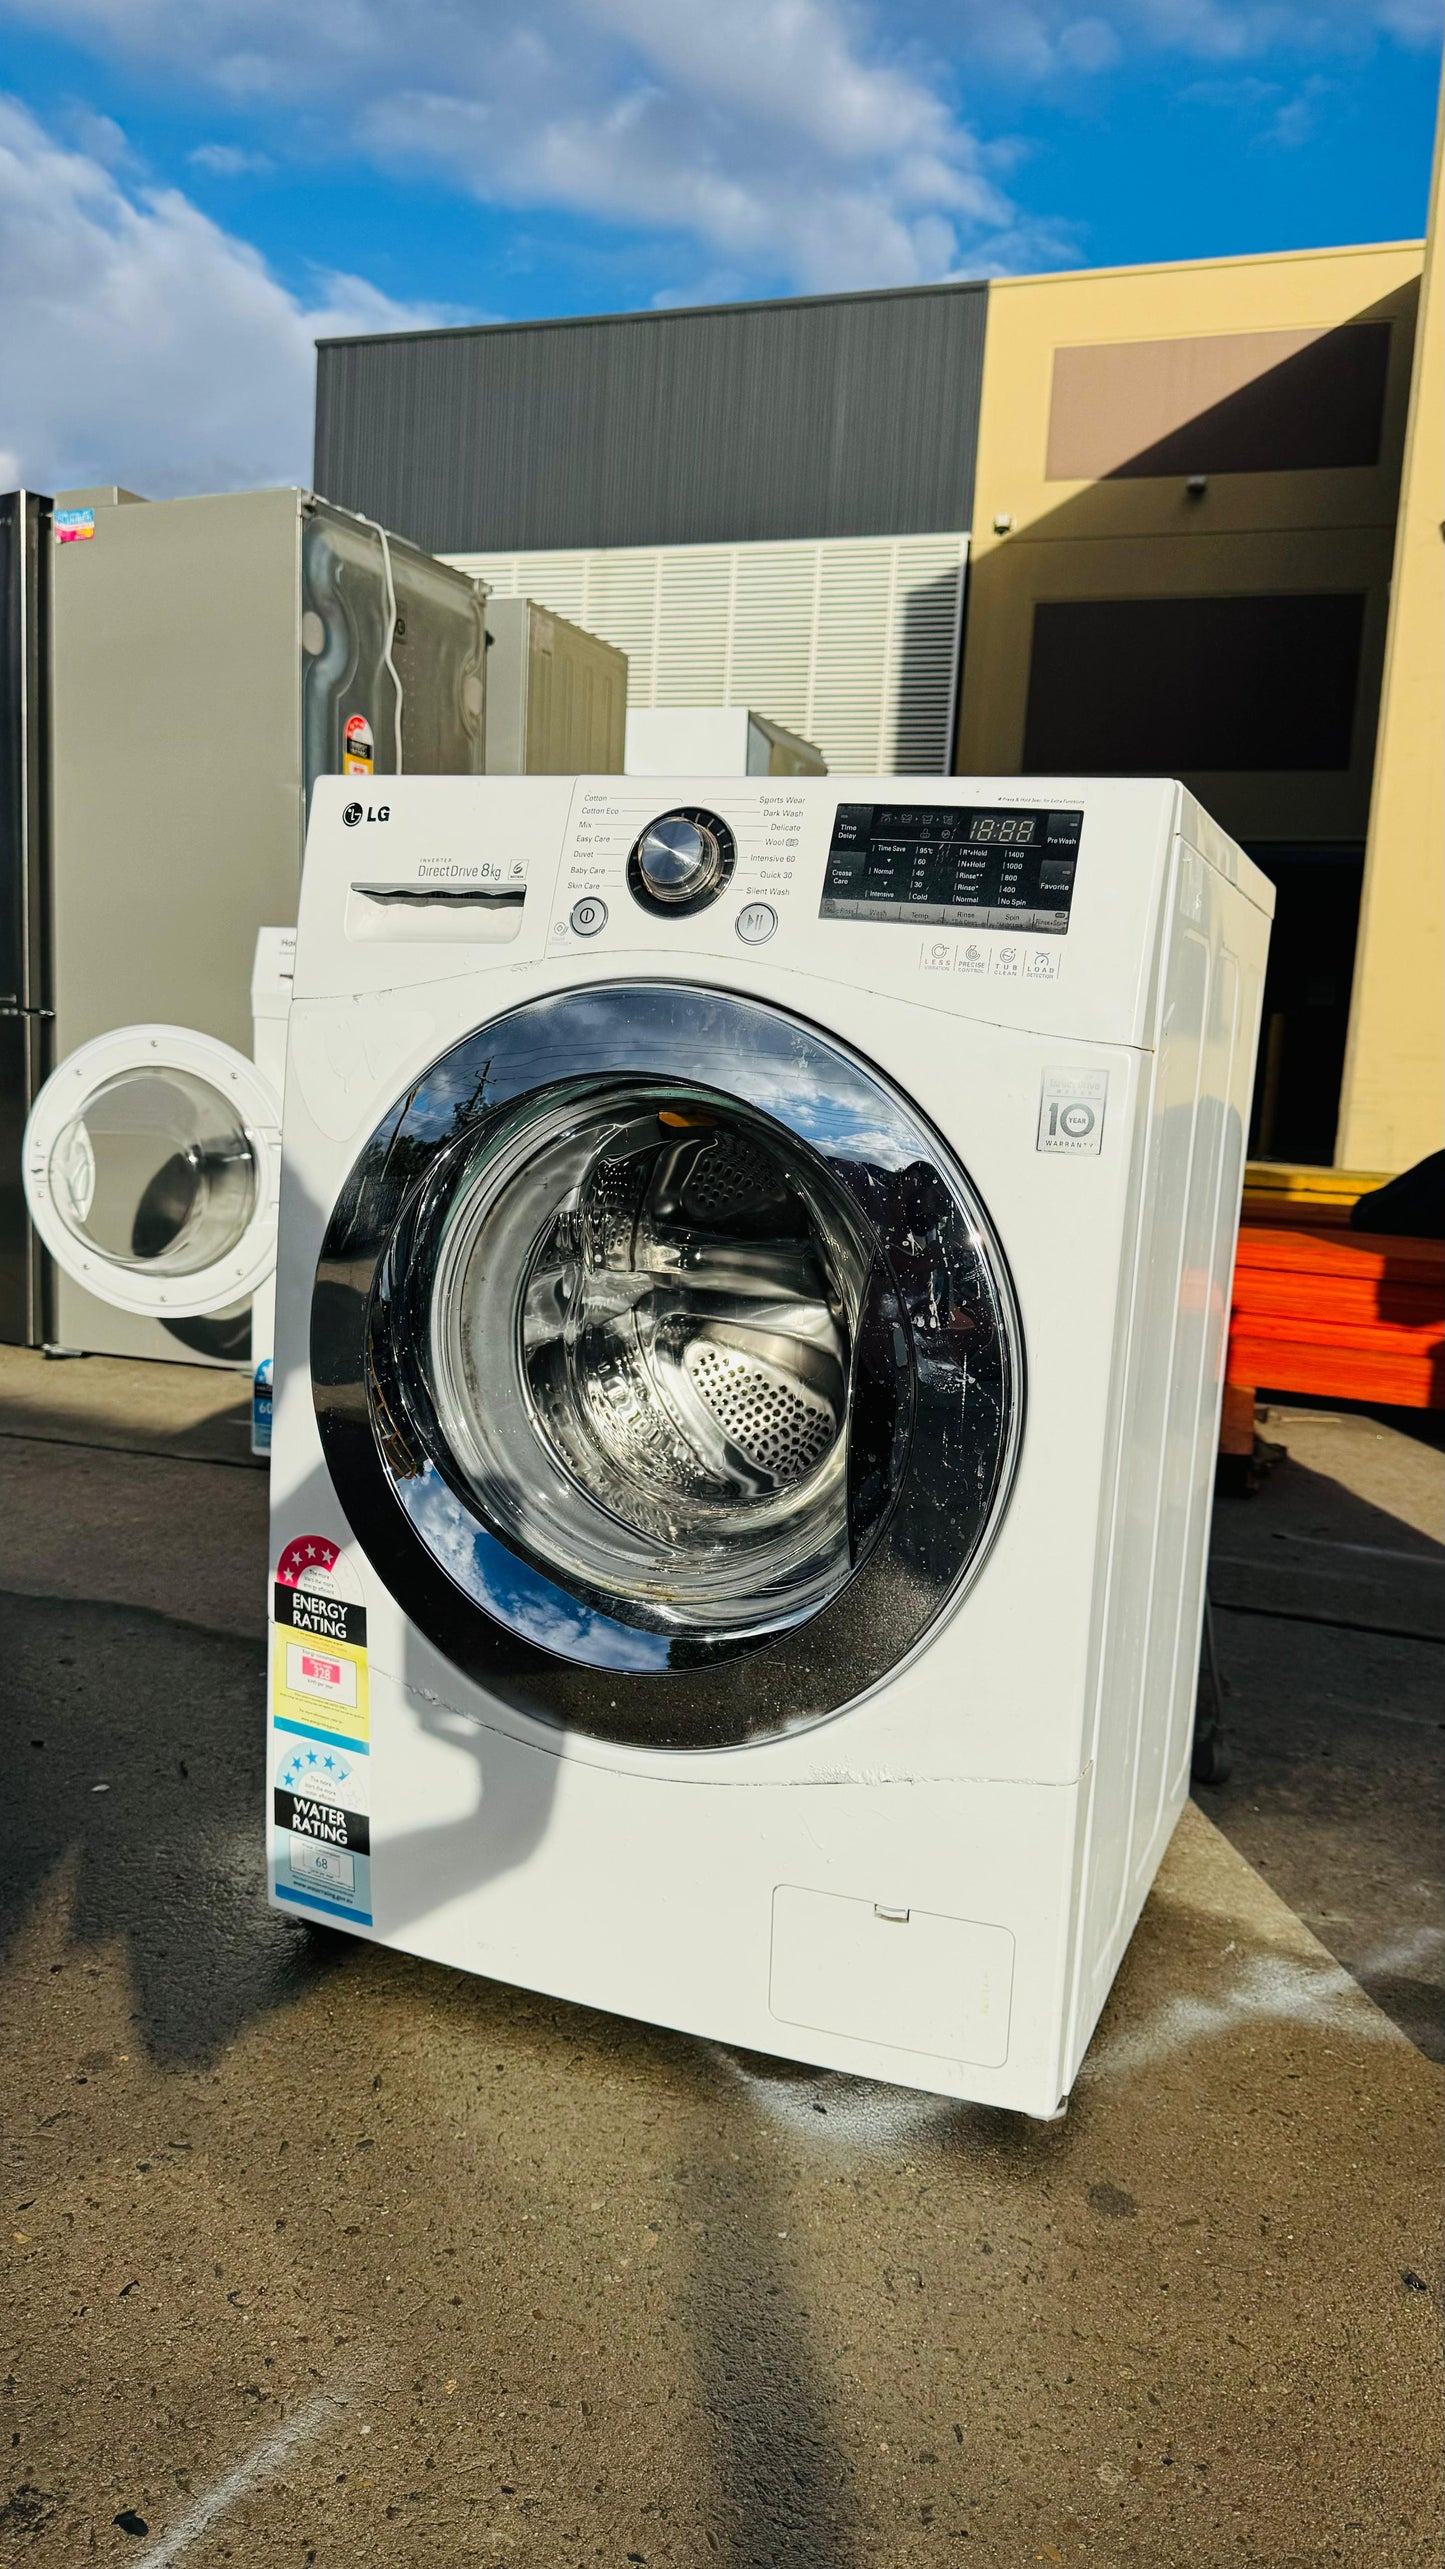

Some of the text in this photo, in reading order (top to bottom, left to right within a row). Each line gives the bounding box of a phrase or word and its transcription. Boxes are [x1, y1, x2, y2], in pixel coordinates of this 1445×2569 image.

[760, 796, 806, 806] Sports Wear
[367, 806, 391, 822] LG
[582, 807, 619, 815] Cotton Eco
[579, 821, 592, 829] Mix
[770, 824, 801, 832] Delicate
[576, 835, 592, 844] Easy
[838, 832, 856, 840] Delay
[765, 838, 784, 846] Wool
[481, 863, 501, 880] 8kg
[570, 867, 587, 876] Baby
[760, 871, 781, 879] Quick
[567, 882, 582, 890] Skin
[746, 887, 790, 896] Silent Wash
[1048, 1102, 1095, 1138] 10
[292, 1592, 348, 1621] ENERGY
[292, 1612, 346, 1639] RATING
[313, 1665, 330, 1680] 328
[293, 1797, 346, 1828] WATER
[292, 1814, 348, 1845] RATING
[316, 1856, 328, 1870] 68
